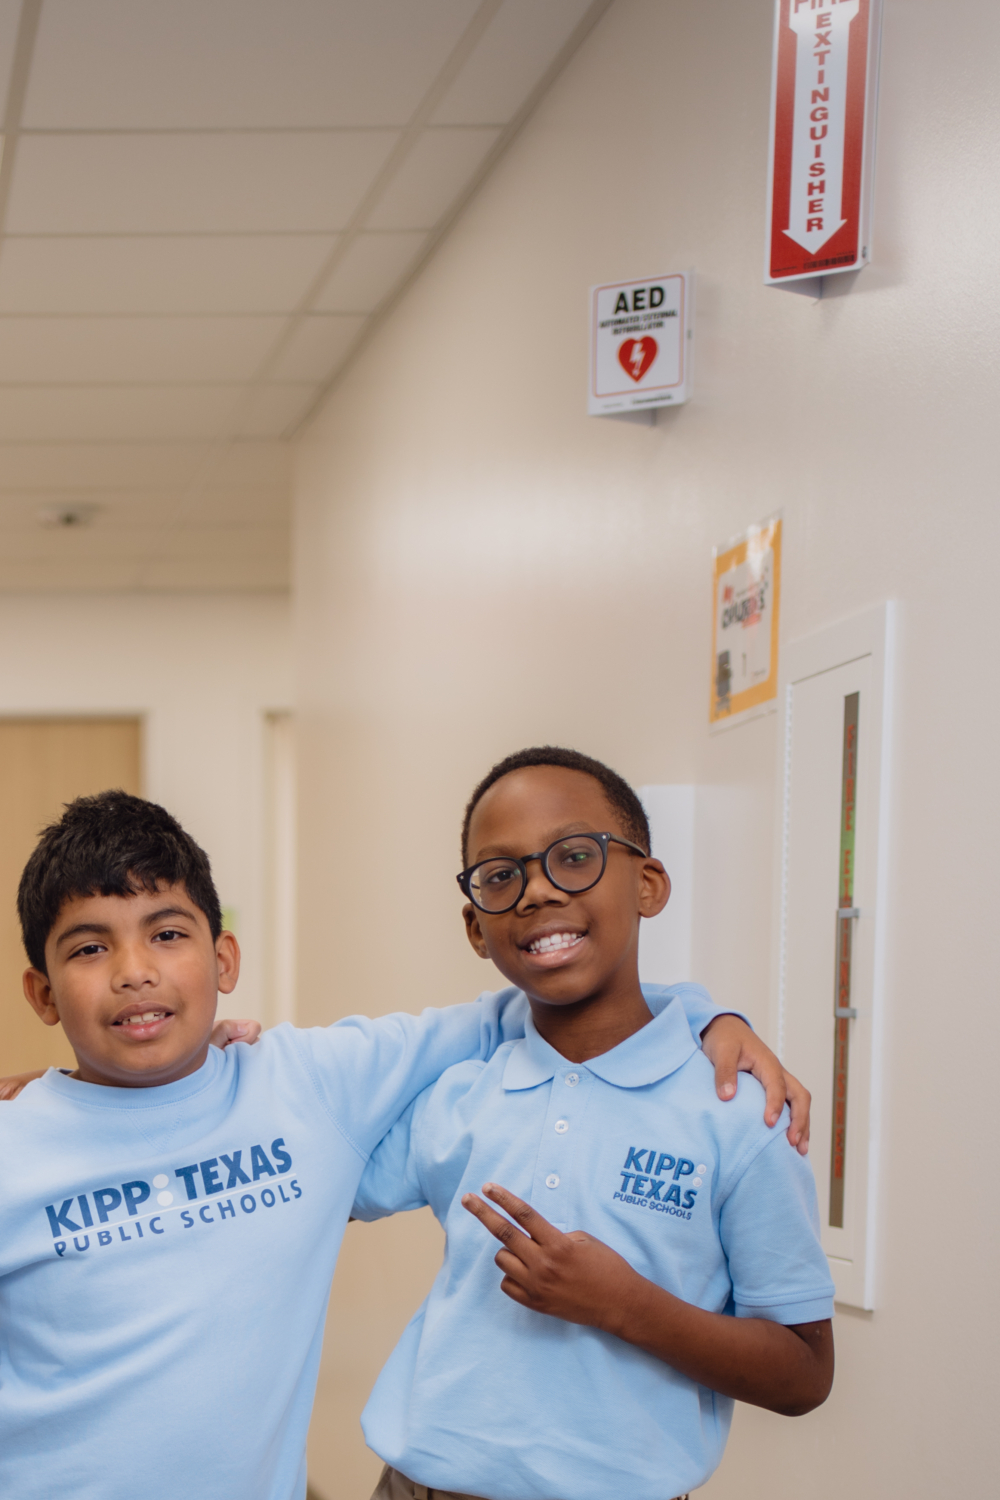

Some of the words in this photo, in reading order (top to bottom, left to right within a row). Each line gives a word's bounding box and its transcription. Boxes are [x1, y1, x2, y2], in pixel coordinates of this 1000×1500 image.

[806, 12, 832, 233] EXTINGUISHER
[613, 286, 665, 315] AED
[174, 1137, 292, 1201] TEXAS
[623, 1146, 695, 1181] KIPP
[612, 1191, 648, 1207] PUBLIC
[648, 1200, 692, 1221] SCHOOLS
[620, 1170, 698, 1209] TEXAS
[54, 1216, 164, 1257] PUBLIC
[180, 1179, 303, 1229] SCHOOLS
